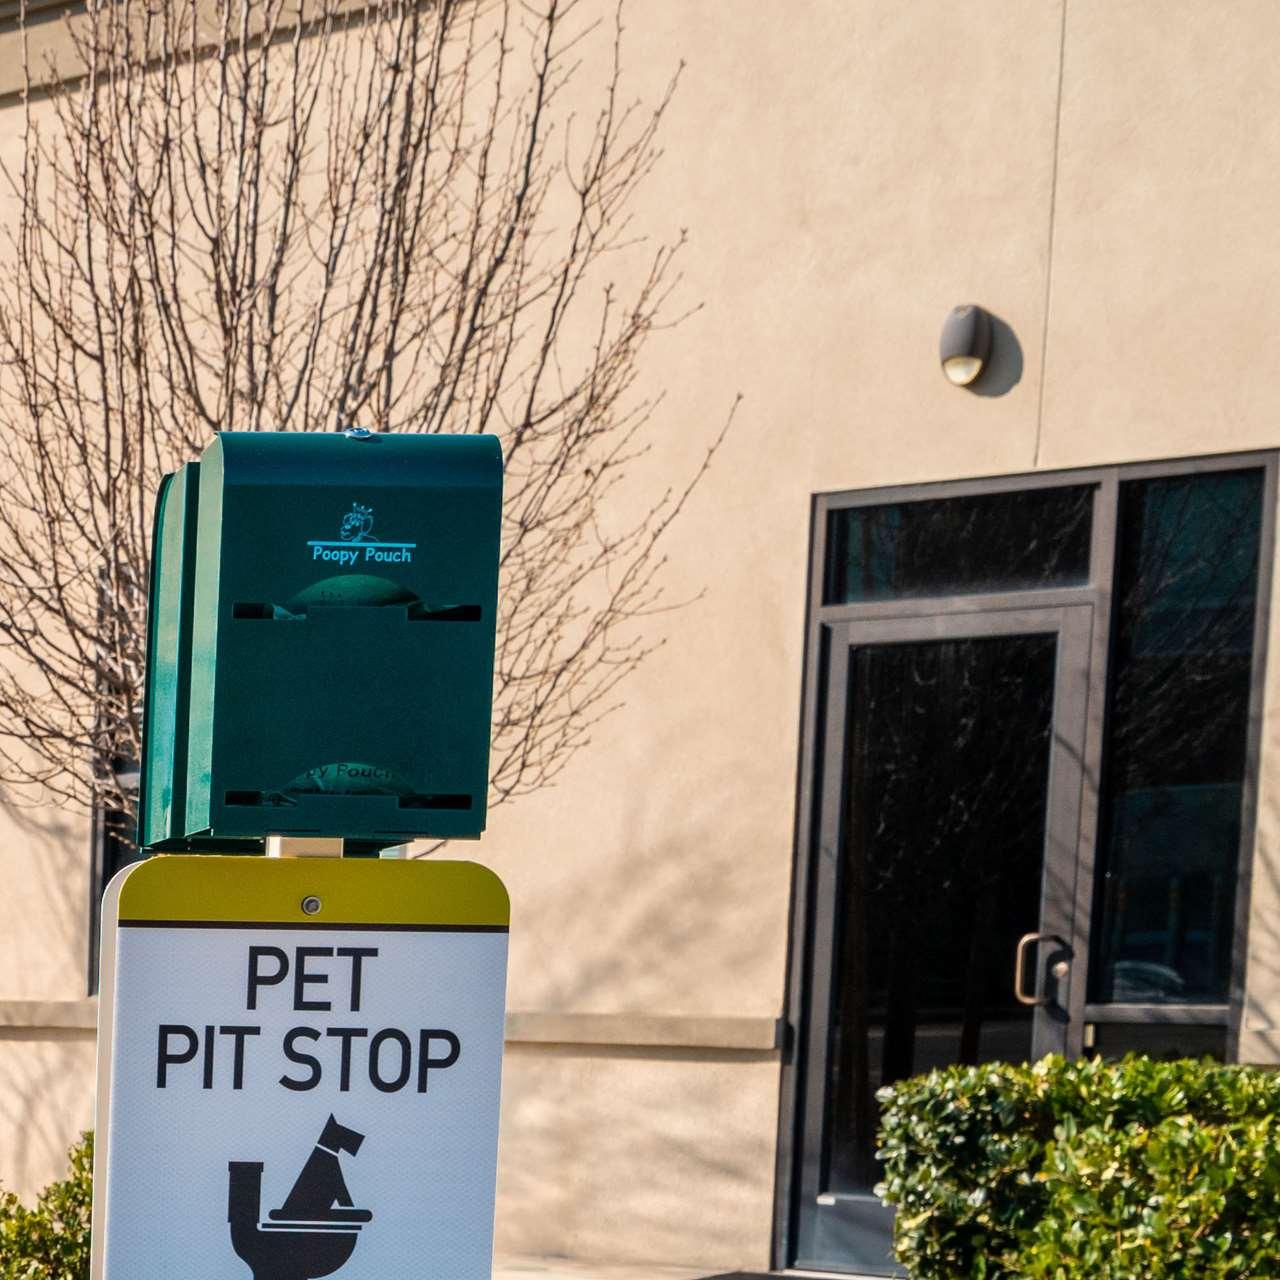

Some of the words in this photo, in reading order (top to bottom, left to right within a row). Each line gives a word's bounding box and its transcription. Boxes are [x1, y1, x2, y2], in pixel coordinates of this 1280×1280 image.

[313, 546, 359, 565] Poopy
[365, 547, 411, 562] Pouch
[246, 945, 379, 1012] PET
[156, 1024, 261, 1090] PIT
[278, 1026, 461, 1094] STOP
